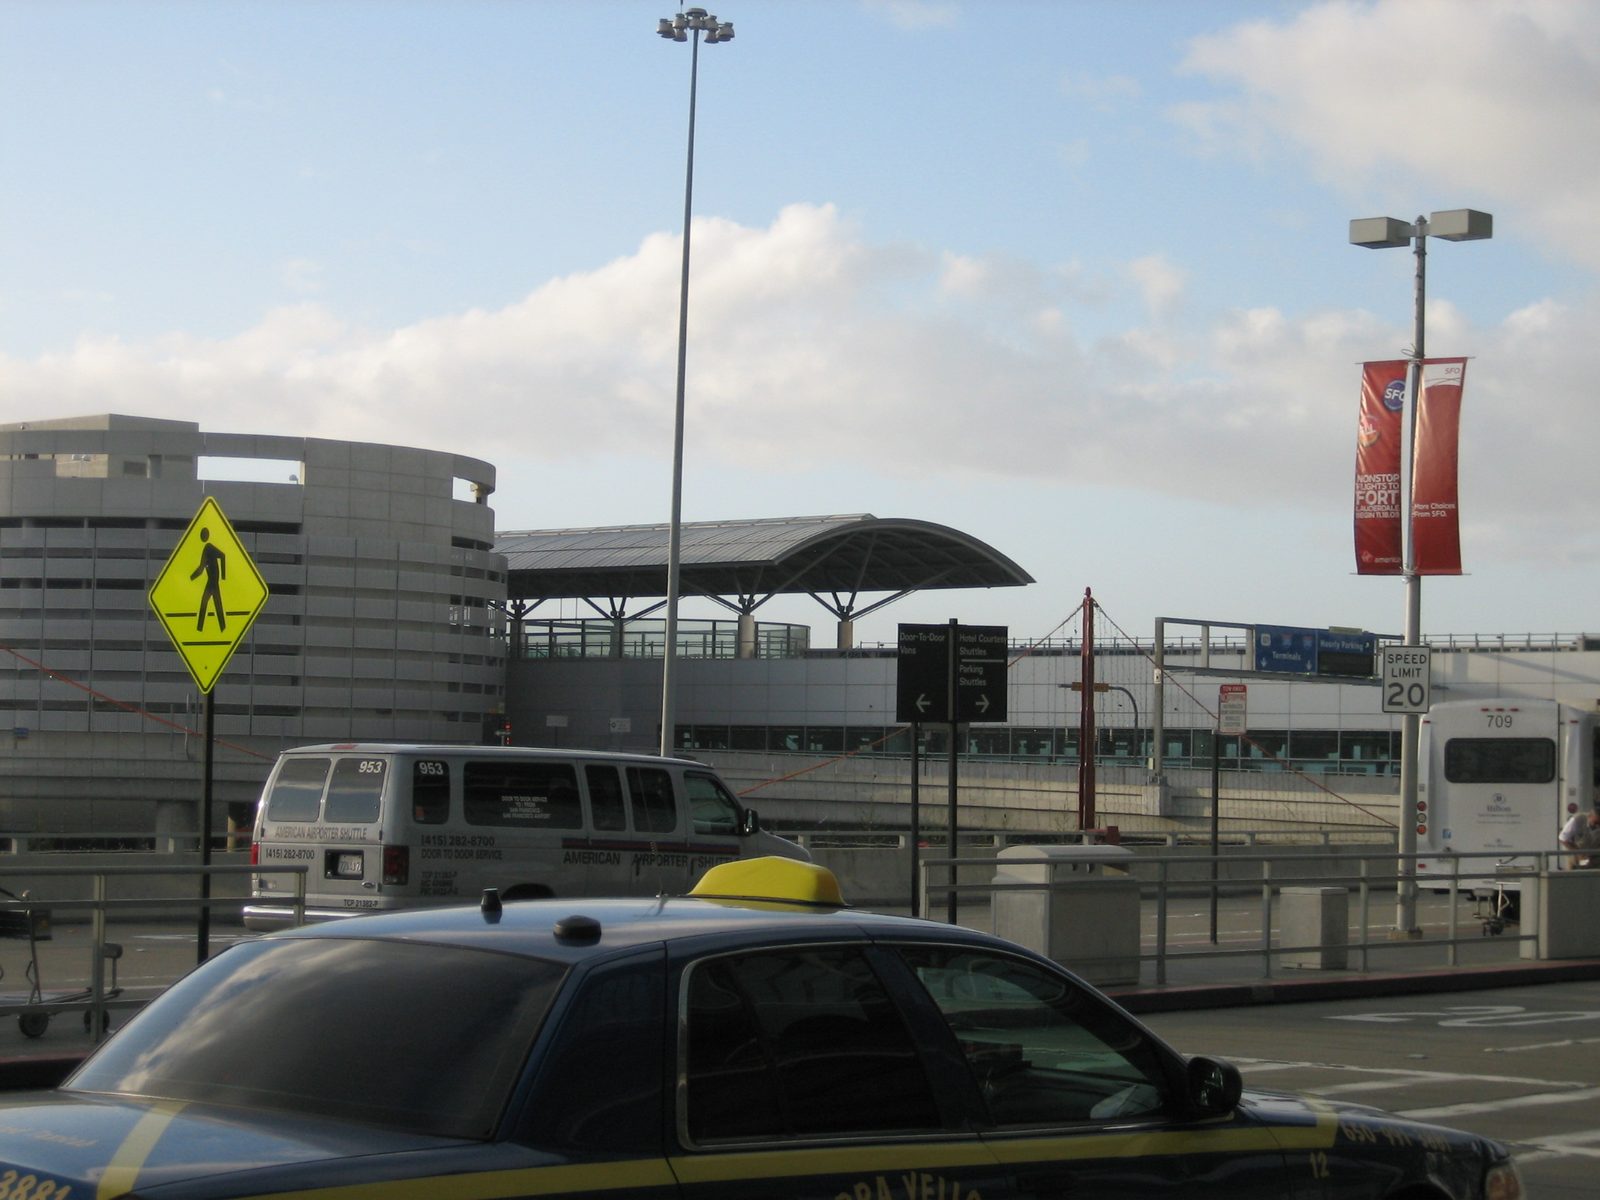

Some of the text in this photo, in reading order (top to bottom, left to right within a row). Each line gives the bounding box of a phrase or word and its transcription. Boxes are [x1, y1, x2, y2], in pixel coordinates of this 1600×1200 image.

[1444, 367, 1460, 375] SFO
[1357, 474, 1400, 483] NONSTOP
[1356, 482, 1400, 491] FLIGHTS TO
[1356, 491, 1400, 505] FORT
[1356, 504, 1400, 512] LAUDERDALE
[900, 631, 945, 642] Door-To-Door
[960, 633, 1007, 645] Hotel Courtesy
[900, 646, 917, 655] Vans
[960, 646, 987, 656] Shuttles
[1341, 641, 1363, 652] Parking
[1272, 651, 1302, 661] Terminals
[1388, 654, 1427, 664] SPEED
[960, 664, 984, 675] Parking
[1391, 667, 1422, 678] LIMIT
[960, 677, 987, 686] Shuttles
[1388, 682, 1425, 707] 20
[1487, 715, 1512, 728] 709
[359, 761, 383, 773] 953
[419, 762, 444, 775] 953
[275, 826, 368, 841] AMERICAN AIRPORTER SHUTTLE
[421, 834, 496, 847] (415) 282-8700
[266, 848, 315, 860] (415) 282-8700
[421, 848, 503, 860] DOOR TO DOOR SERVICE
[563, 851, 622, 866] AMERICAN
[344, 899, 355, 907] TCP
[1310, 1151, 1330, 1179] 12
